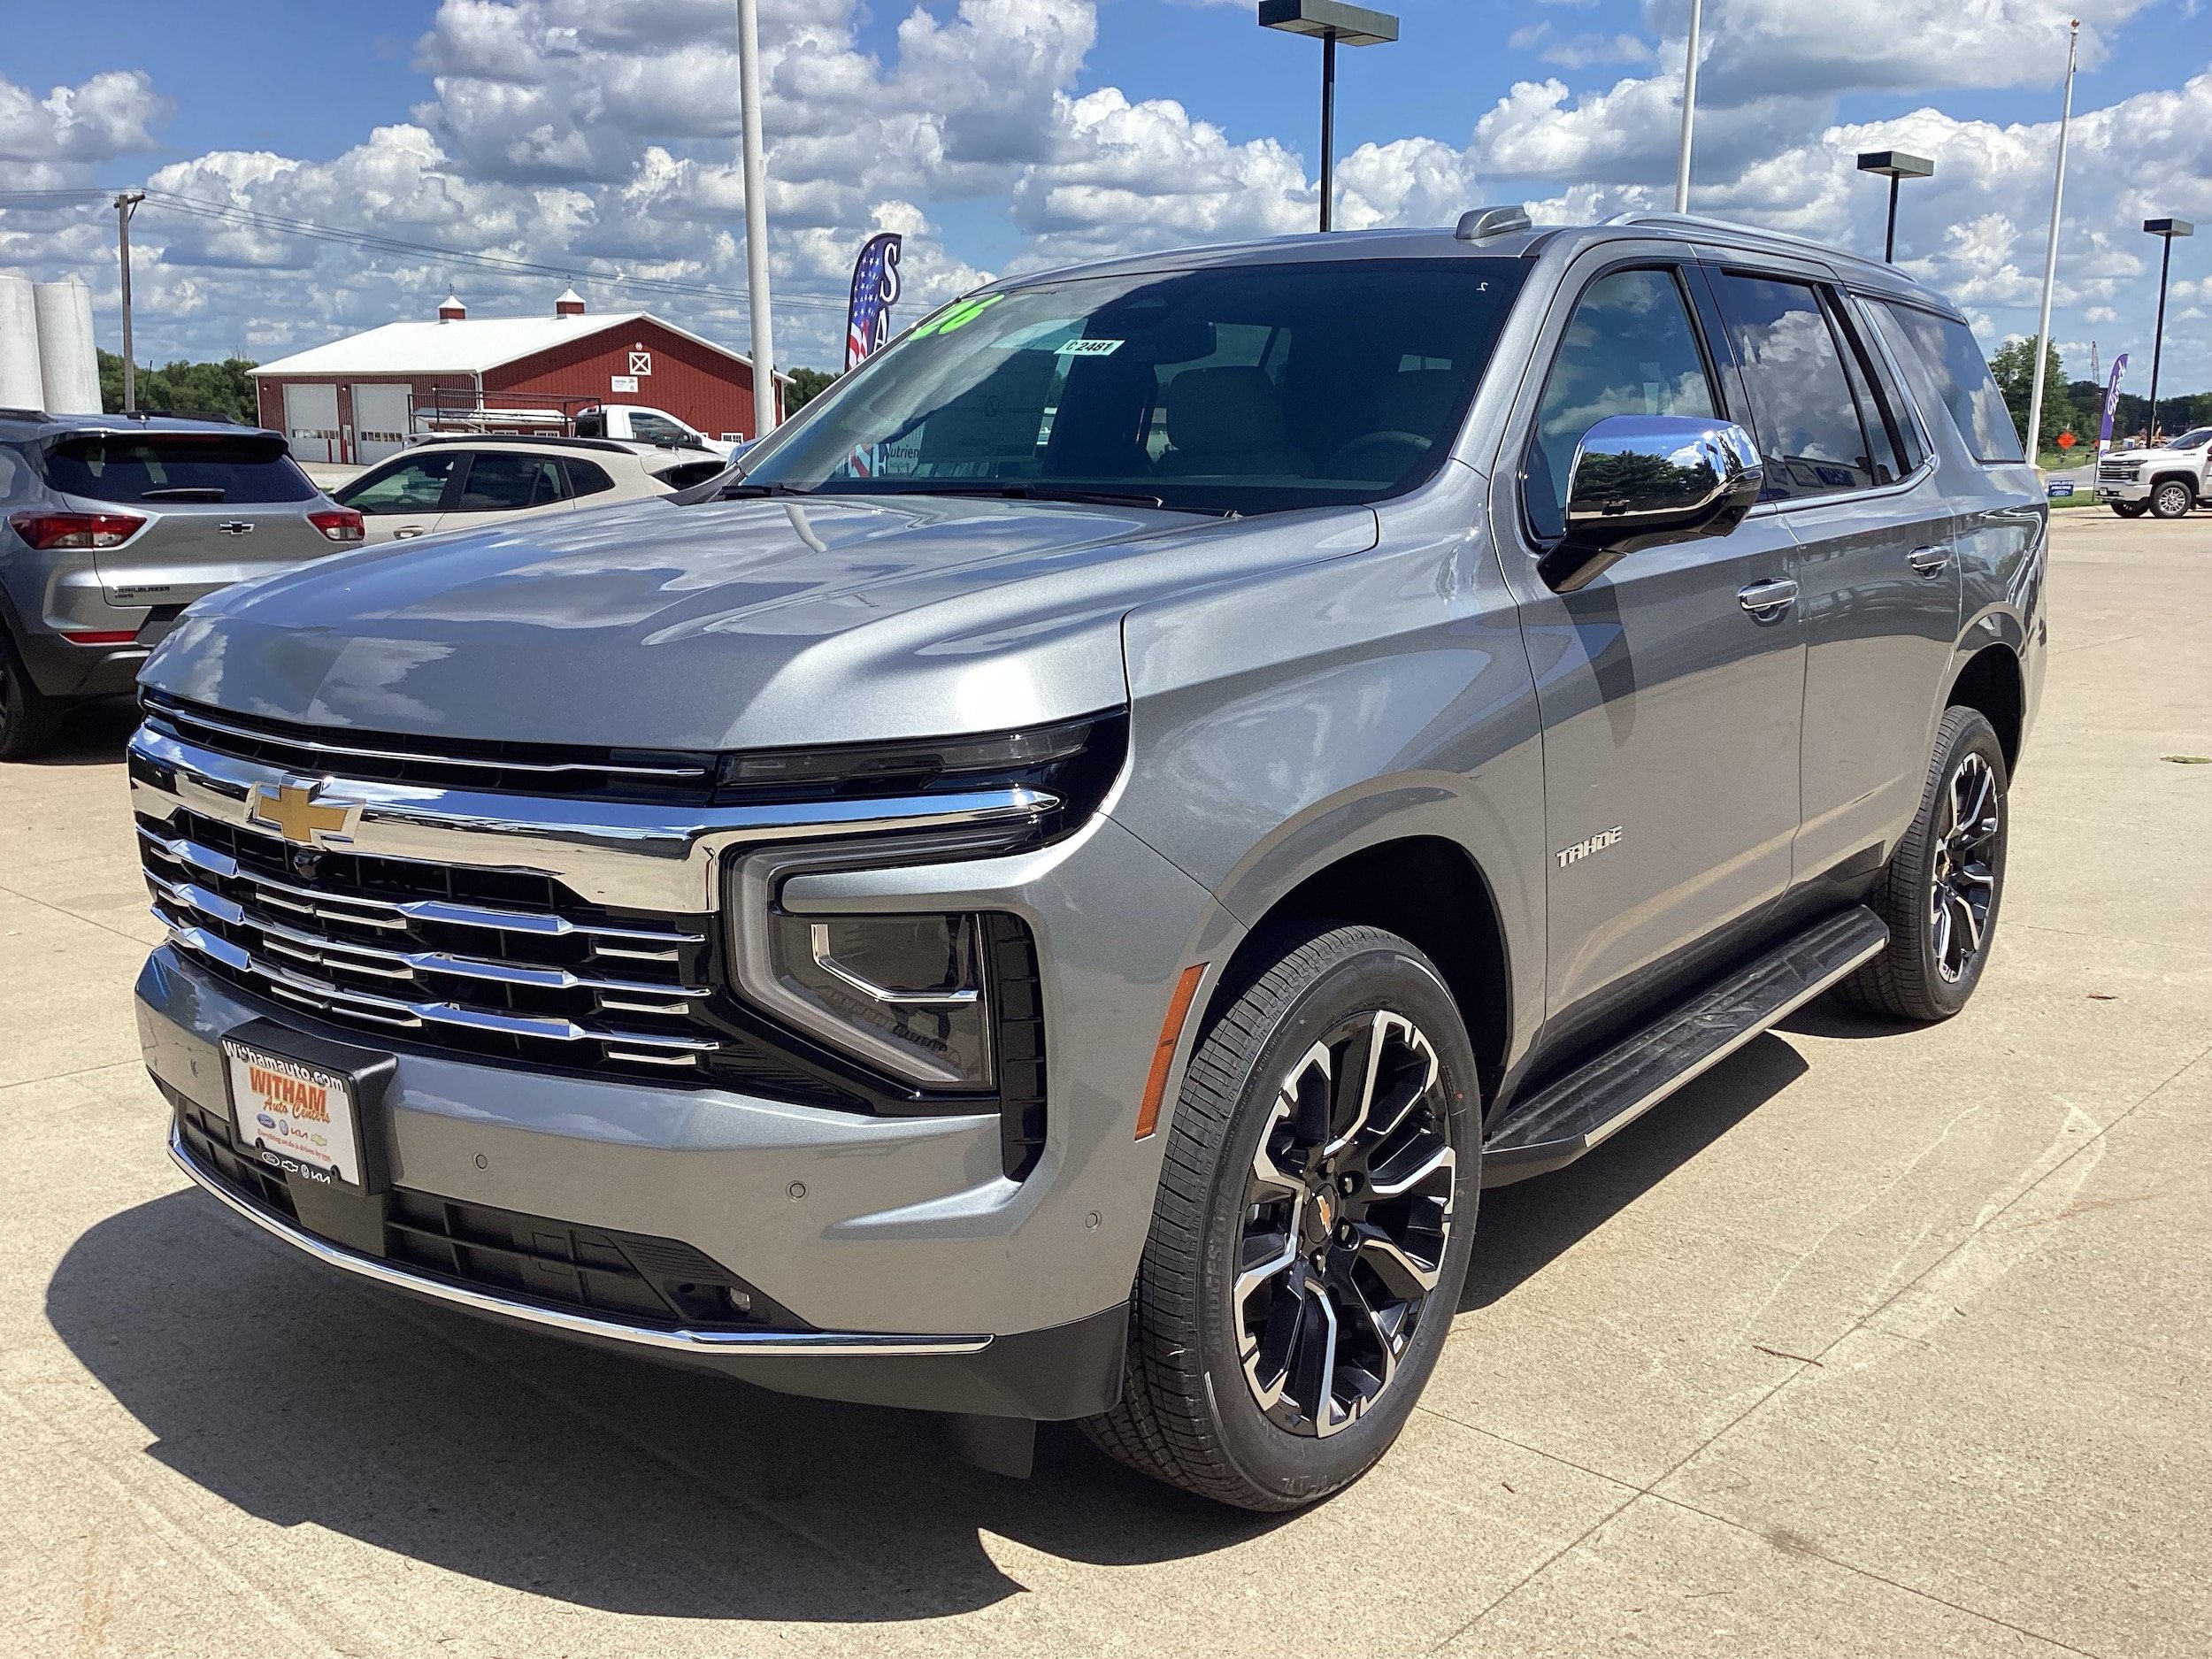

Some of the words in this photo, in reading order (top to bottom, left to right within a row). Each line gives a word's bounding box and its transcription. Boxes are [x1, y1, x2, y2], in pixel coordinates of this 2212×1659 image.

[1075, 342, 1115, 351] 2481
[1555, 825, 1623, 868] TAHOE
[249, 1066, 326, 1116] WITHAM
[264, 1095, 288, 1115] Auto
[292, 1100, 331, 1124] Centers
